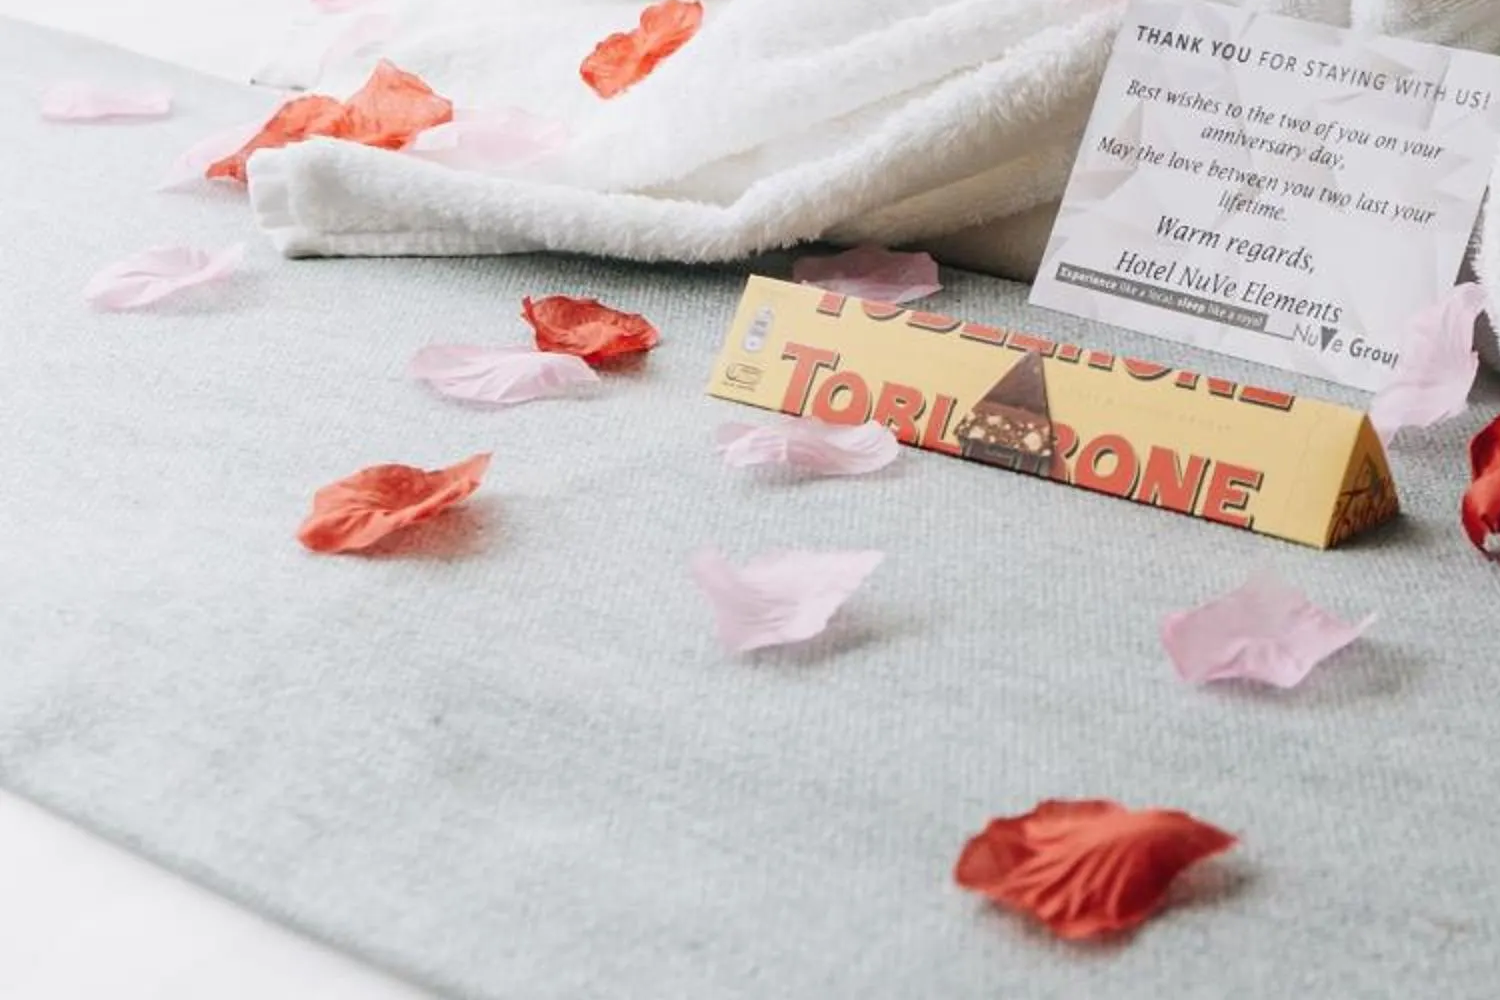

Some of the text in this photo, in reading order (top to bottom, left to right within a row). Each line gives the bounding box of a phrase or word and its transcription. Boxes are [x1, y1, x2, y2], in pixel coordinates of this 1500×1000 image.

[1136, 25, 1492, 110] THANK YOU FOR STAYING WITH US!
[1126, 79, 1447, 160] Best wishes to the two of you on your
[1201, 125, 1345, 171] anniversary day,
[1097, 136, 1436, 225] May the love between you two last your
[1218, 189, 1287, 221] lifetime.
[1060, 267, 1118, 290] Experience
[1156, 215, 1315, 274] Warm regards,
[1116, 250, 1343, 324] Hotel NuVe Elements
[781, 341, 1265, 530] TOBLRONE
